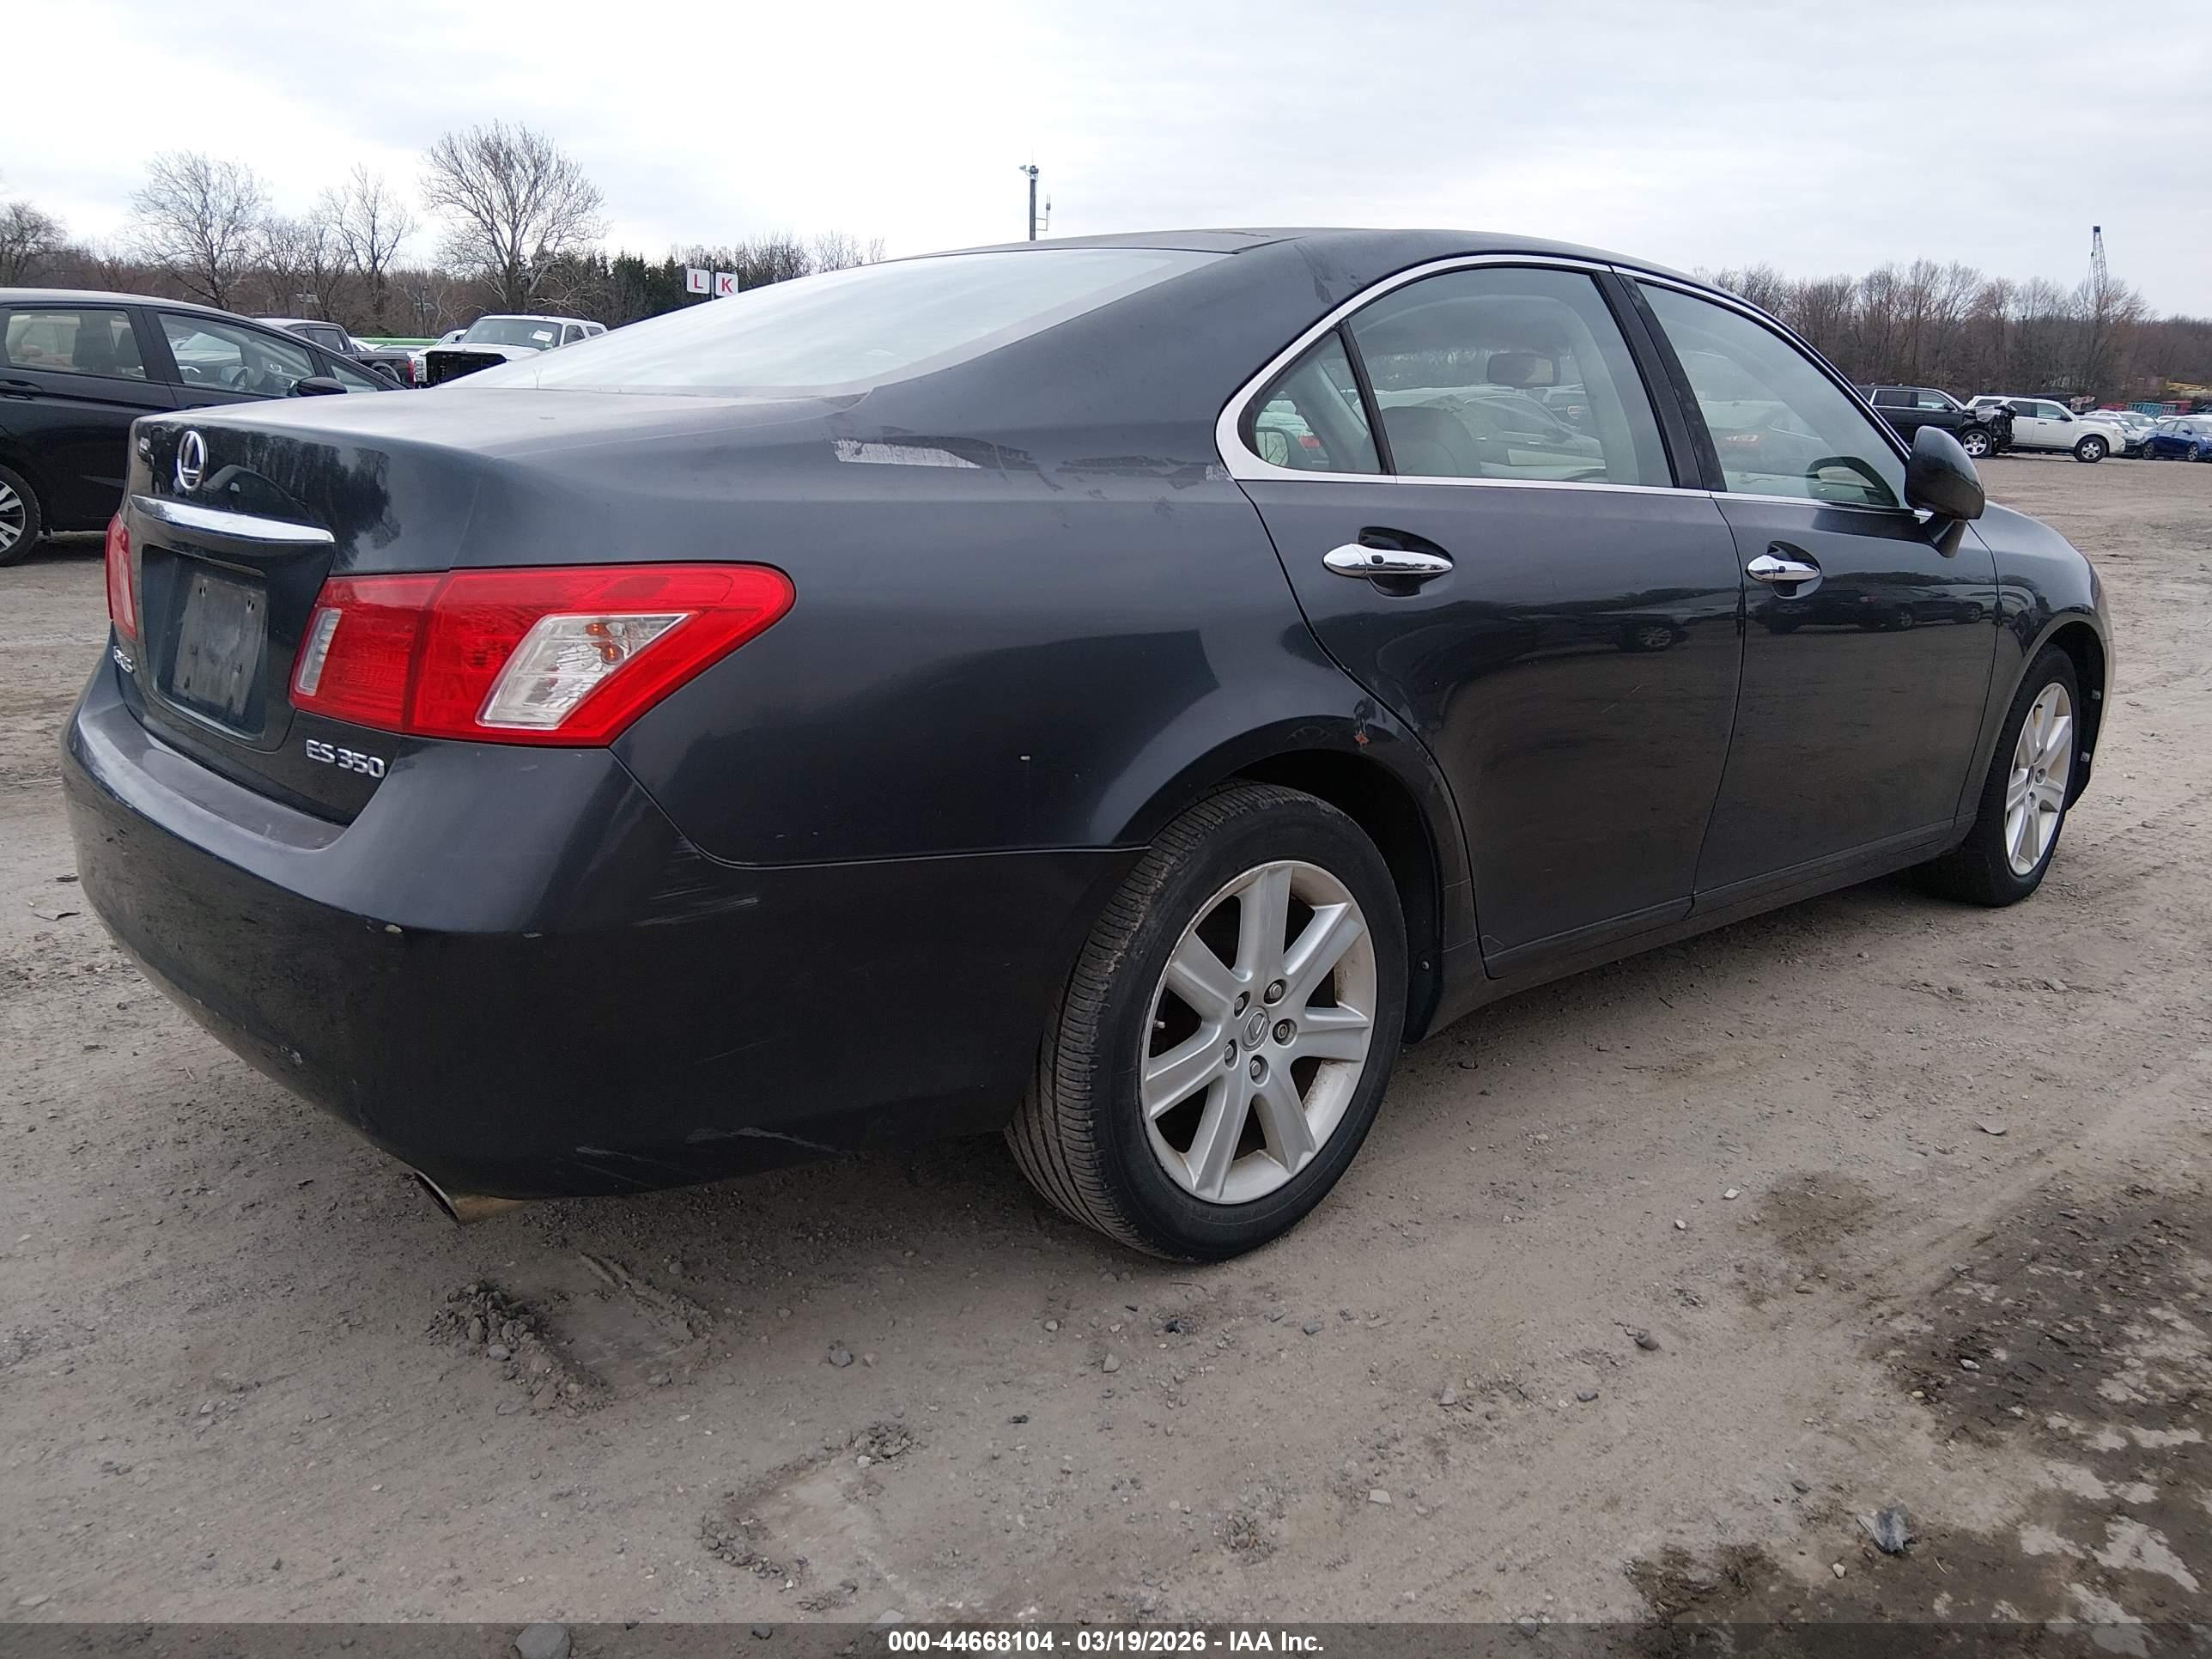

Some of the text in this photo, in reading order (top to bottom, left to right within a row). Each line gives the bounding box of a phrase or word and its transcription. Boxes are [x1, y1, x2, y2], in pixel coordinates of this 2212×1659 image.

[694, 273, 704, 289] L
[721, 276, 733, 294] K
[306, 739, 385, 778] ES 350
